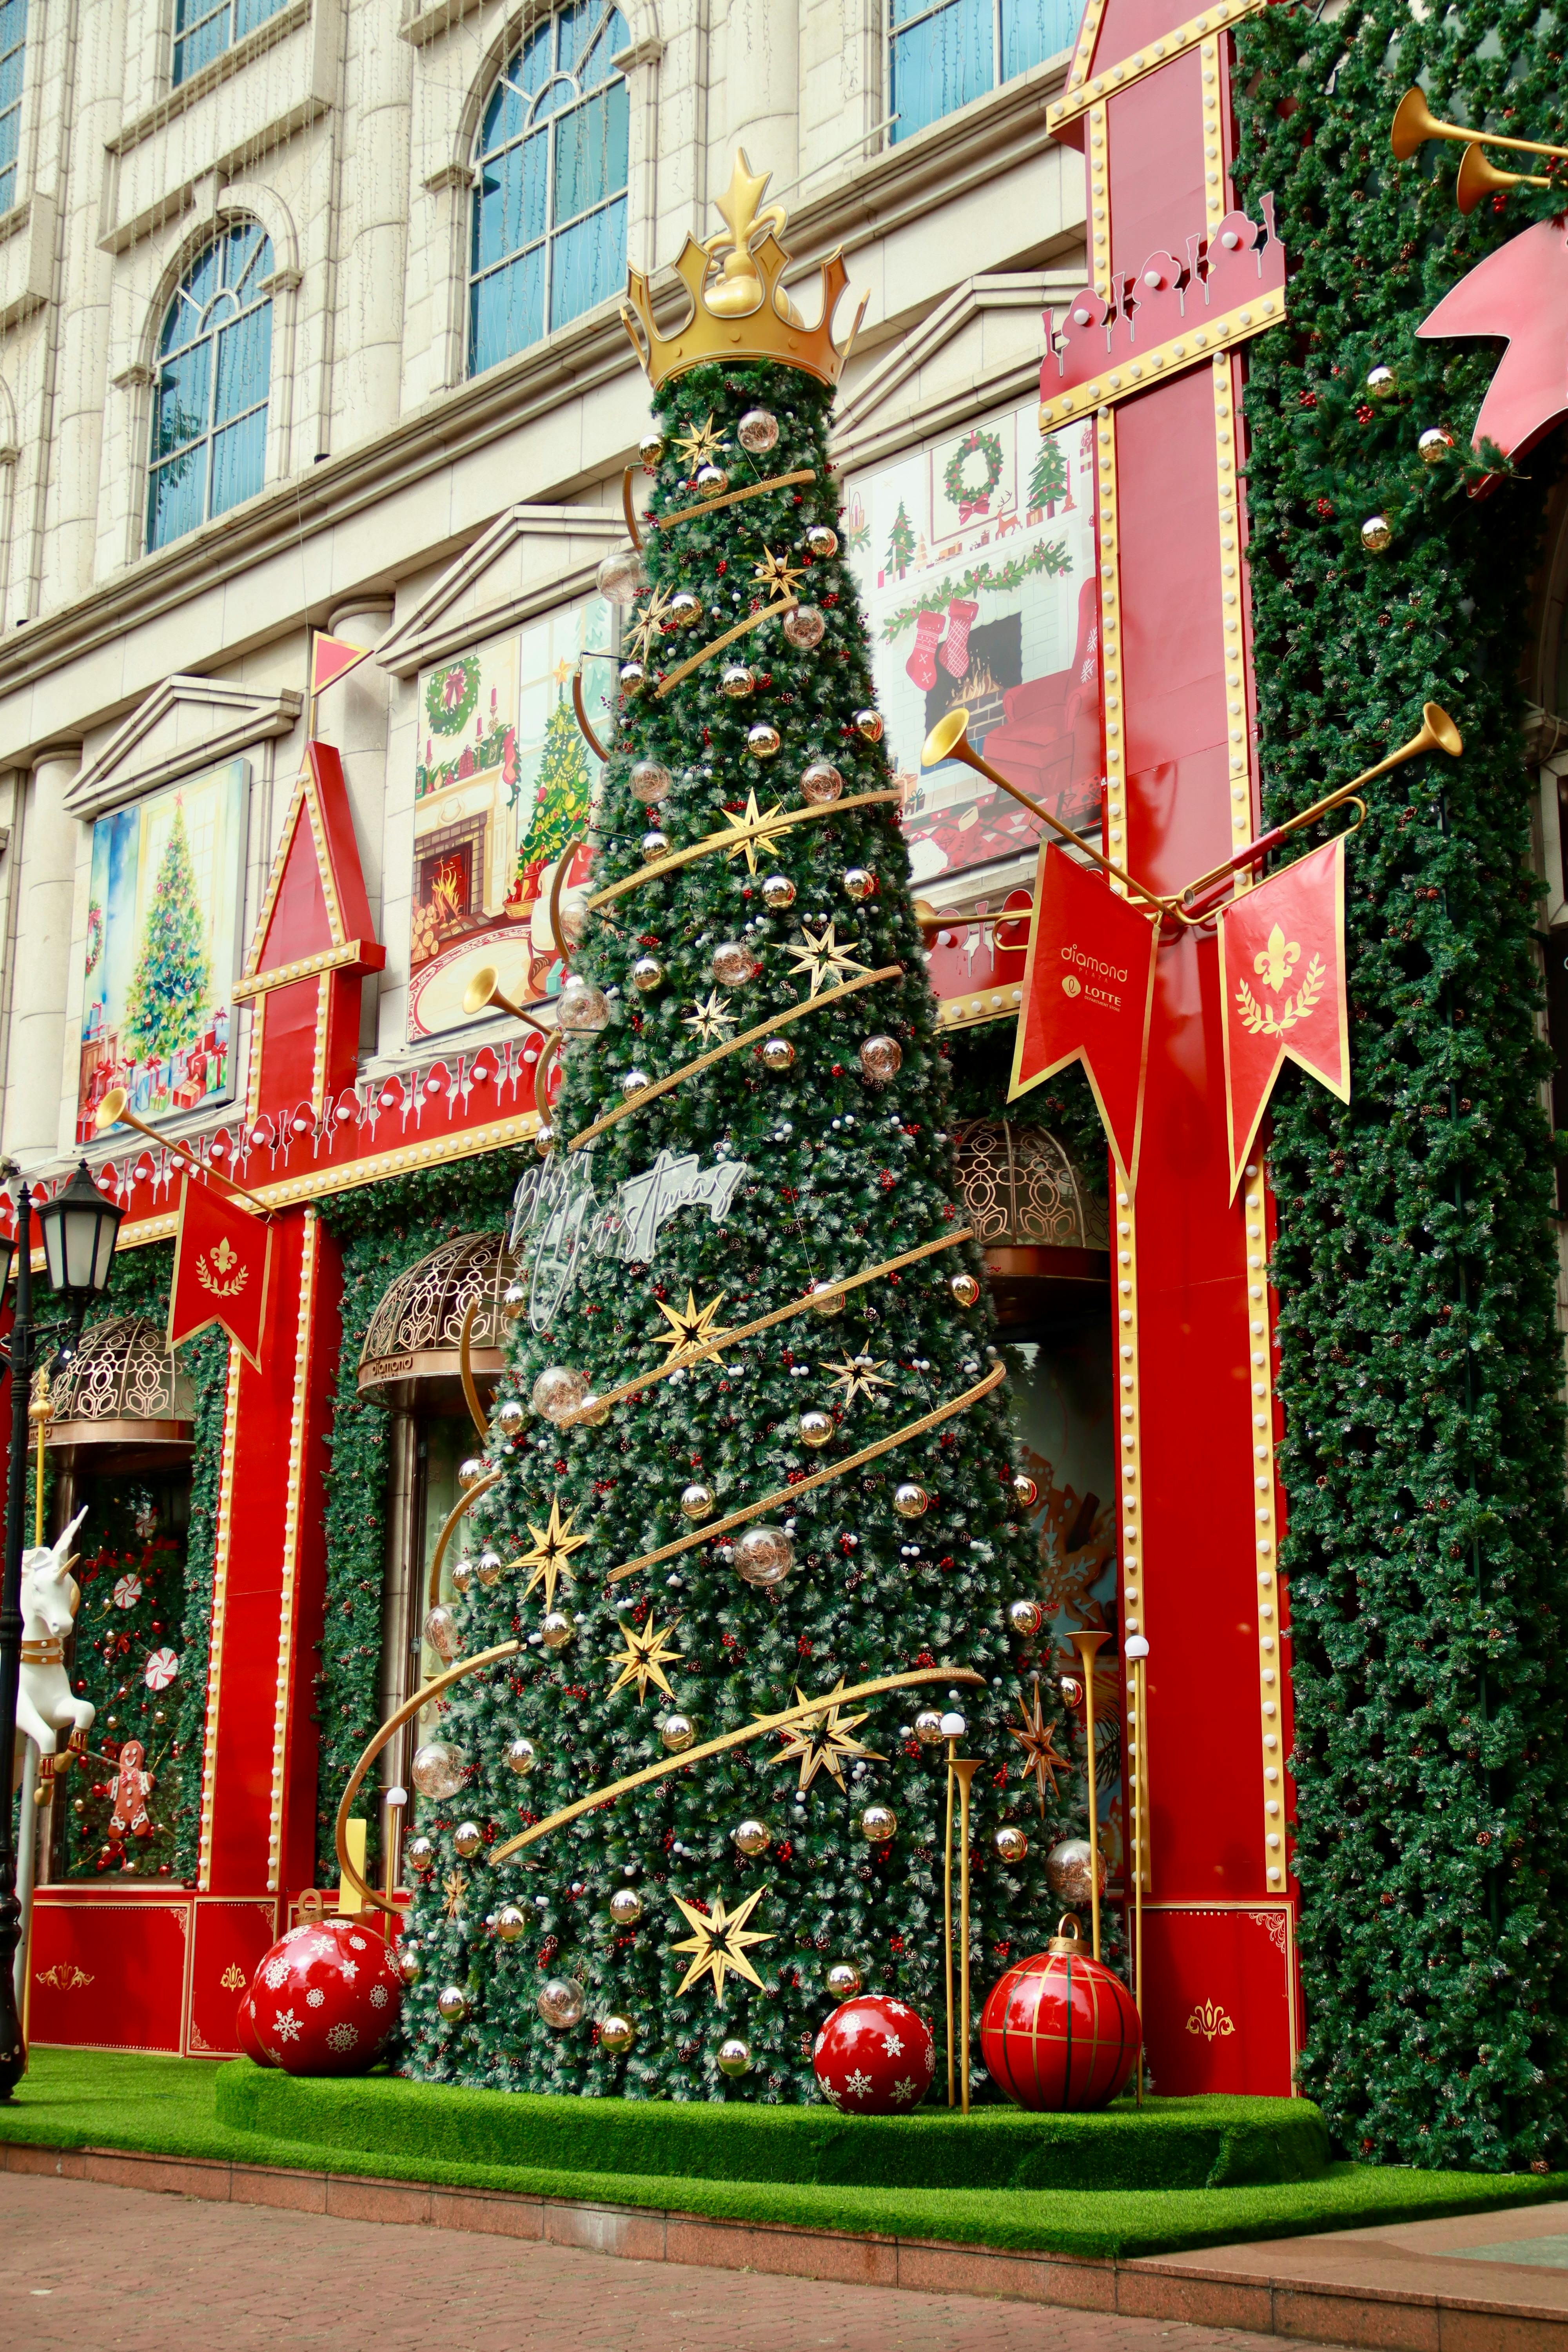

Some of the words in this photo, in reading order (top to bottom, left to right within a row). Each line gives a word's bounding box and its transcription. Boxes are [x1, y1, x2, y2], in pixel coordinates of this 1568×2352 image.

[1061, 944, 1127, 982] diamond
[1079, 967, 1108, 984] PLAZA
[1084, 995, 1109, 1008] DEPARTMENT
[1085, 984, 1122, 1007] LOTTE
[530, 1154, 744, 1333] Christmas
[372, 1356, 413, 1376] diamond
